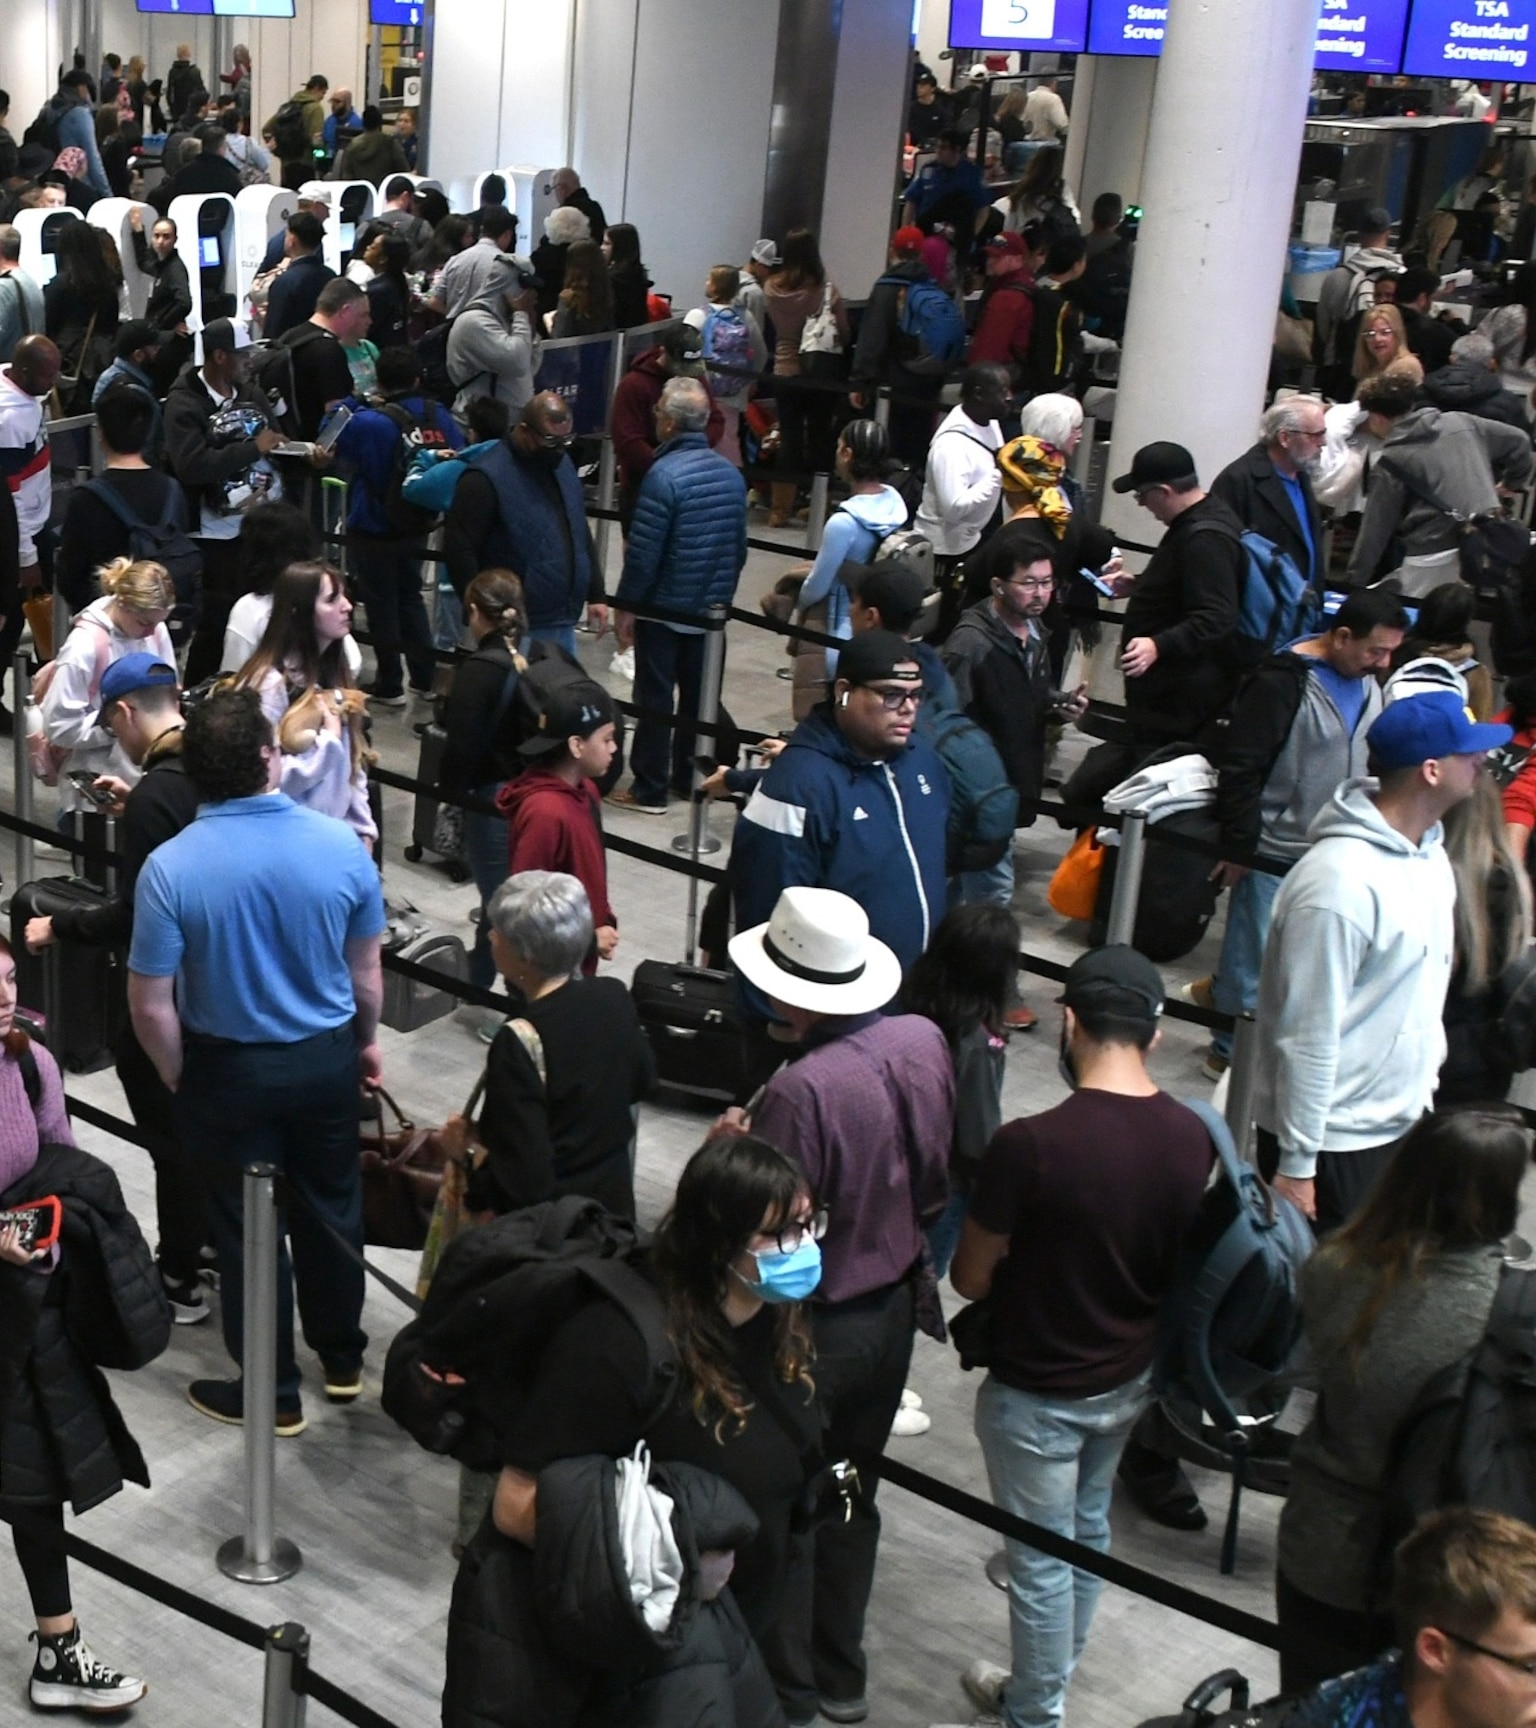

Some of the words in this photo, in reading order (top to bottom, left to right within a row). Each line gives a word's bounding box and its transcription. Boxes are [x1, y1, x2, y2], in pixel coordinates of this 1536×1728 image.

[1008, 0, 1028, 24] 5
[1324, 0, 1348, 10] SA
[1475, 1, 1510, 17] TSA
[1122, 24, 1165, 40] Scree
[1316, 14, 1367, 32] ndard
[1449, 21, 1530, 41] Standard
[1443, 43, 1528, 67] Screening
[402, 426, 446, 448] idas
